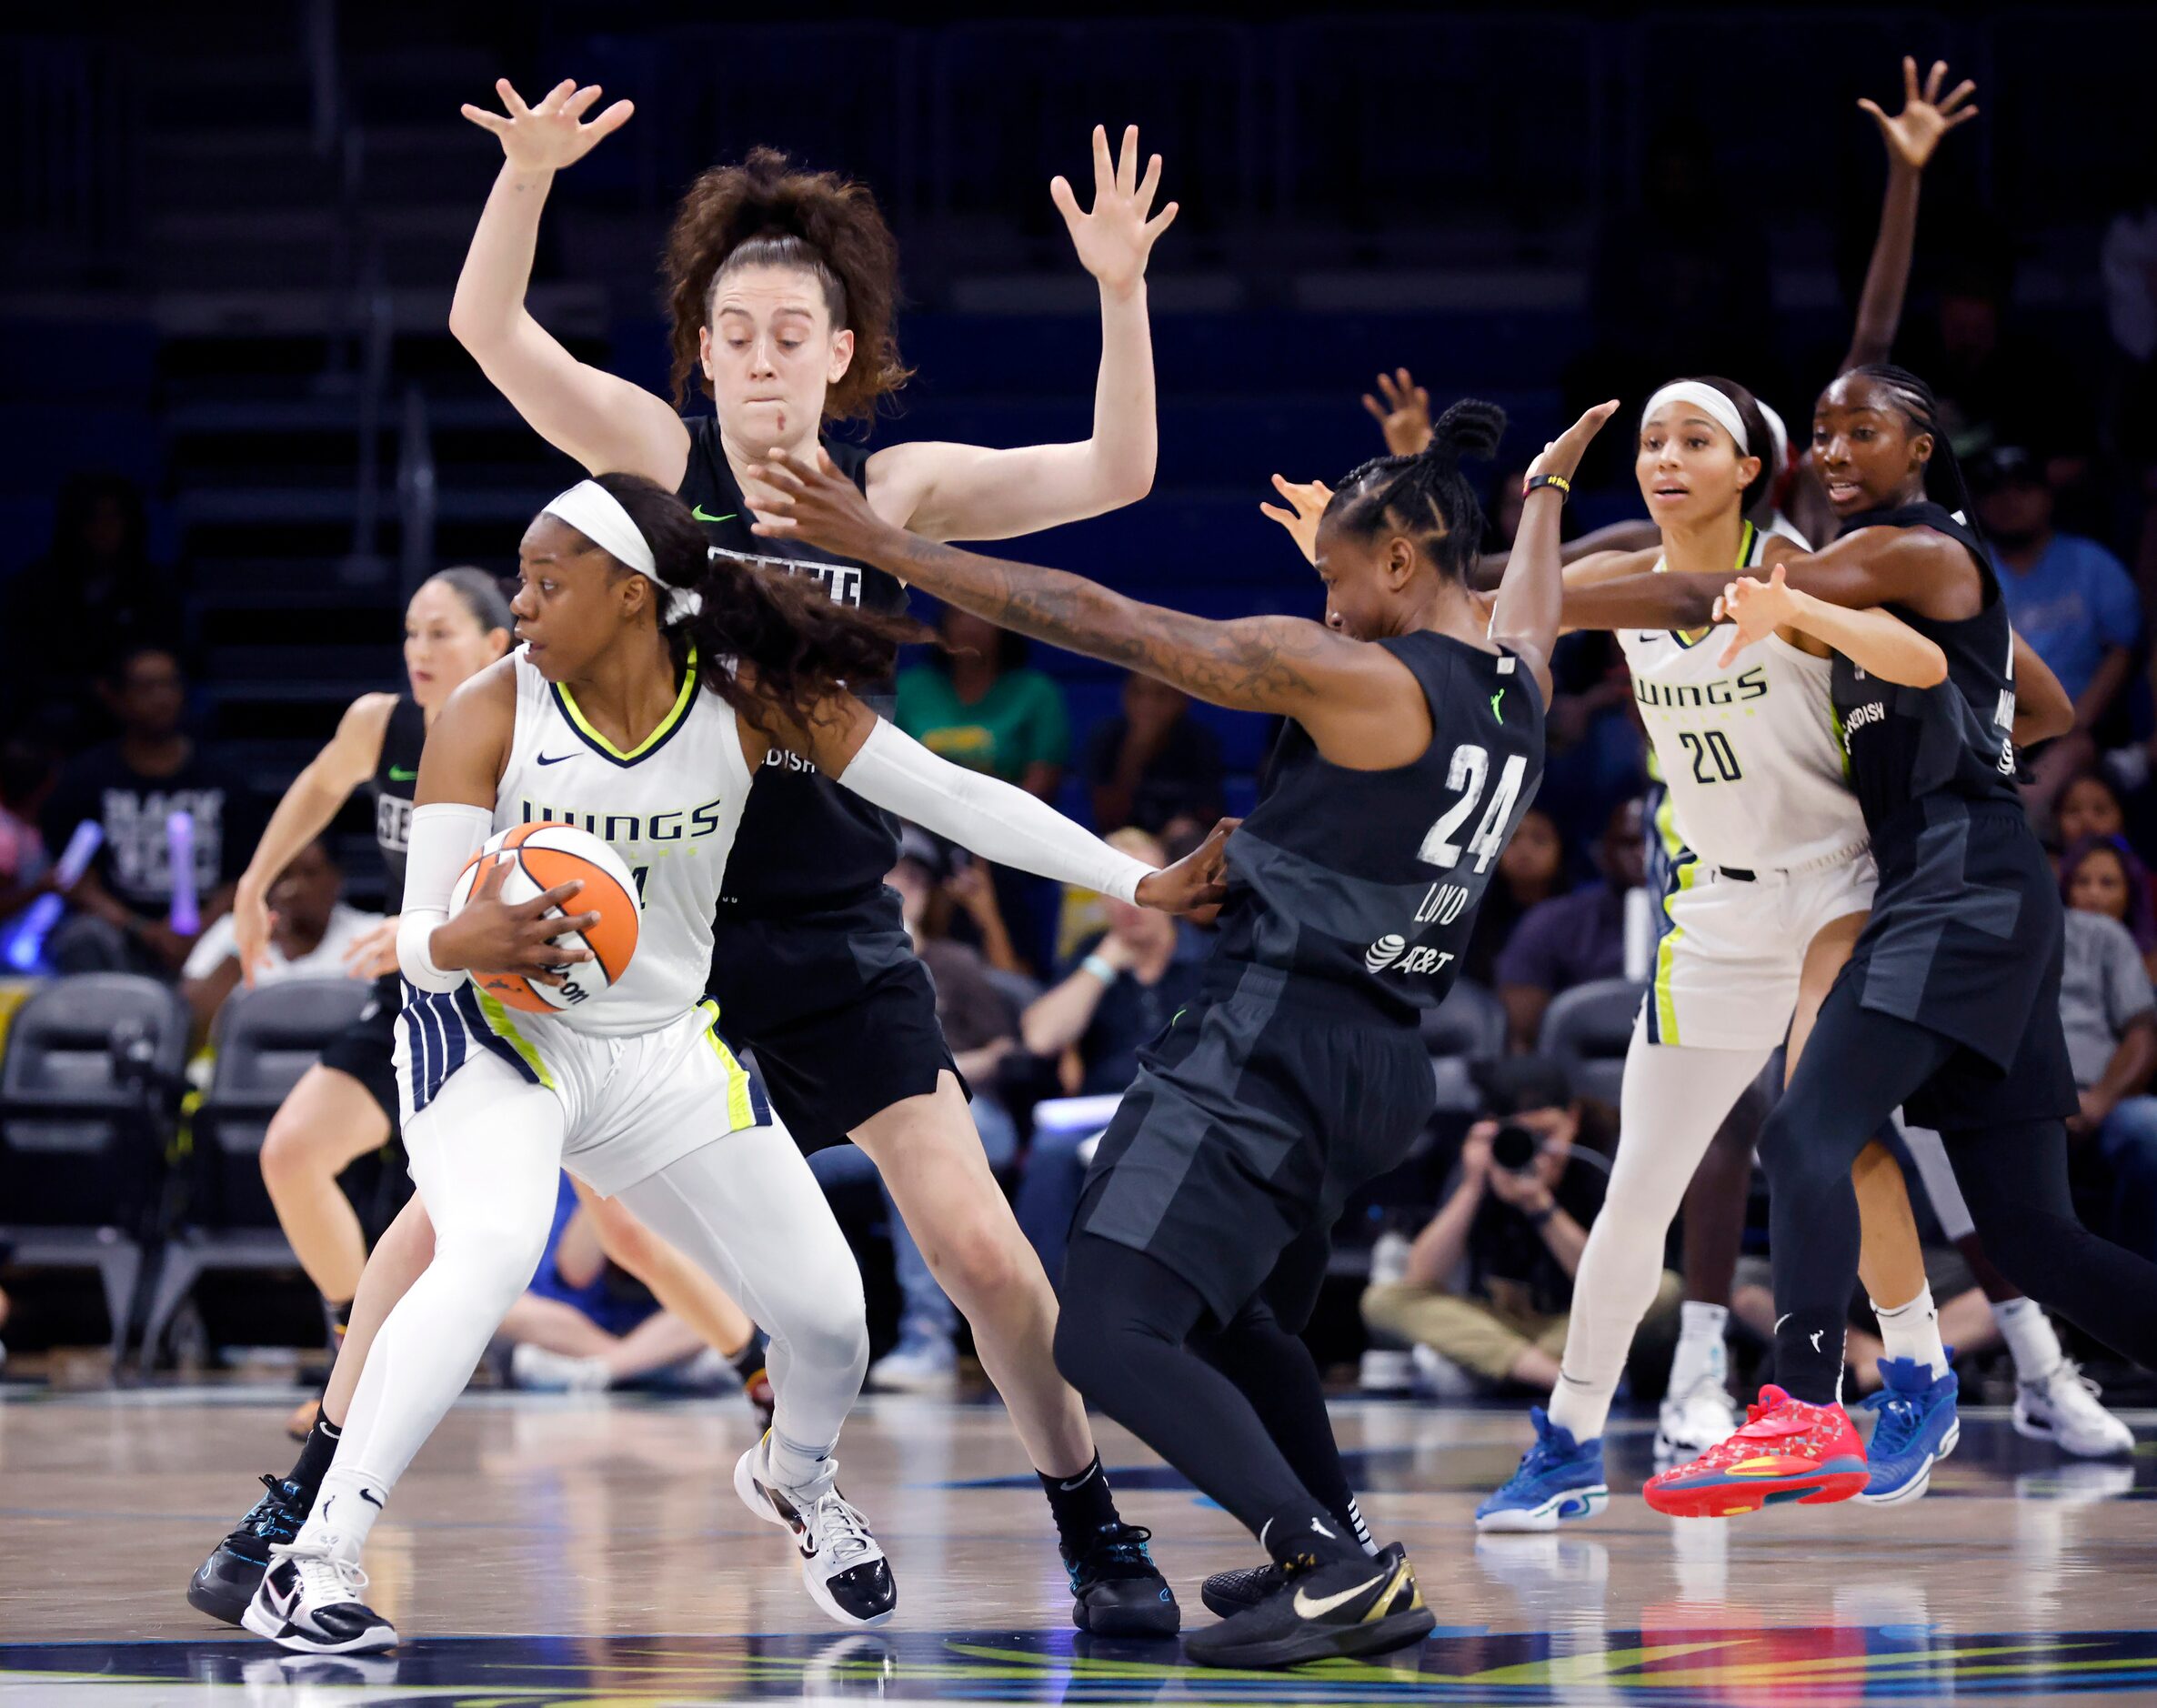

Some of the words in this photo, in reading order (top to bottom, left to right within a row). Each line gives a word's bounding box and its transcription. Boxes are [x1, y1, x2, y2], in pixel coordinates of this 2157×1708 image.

[1637, 666, 1768, 707] WINGS
[762, 748, 816, 773] DISH
[1679, 730, 1742, 784] 20
[1416, 744, 1528, 874] 24
[1414, 882, 1470, 926] LOYD
[1391, 946, 1454, 975] AT&T
